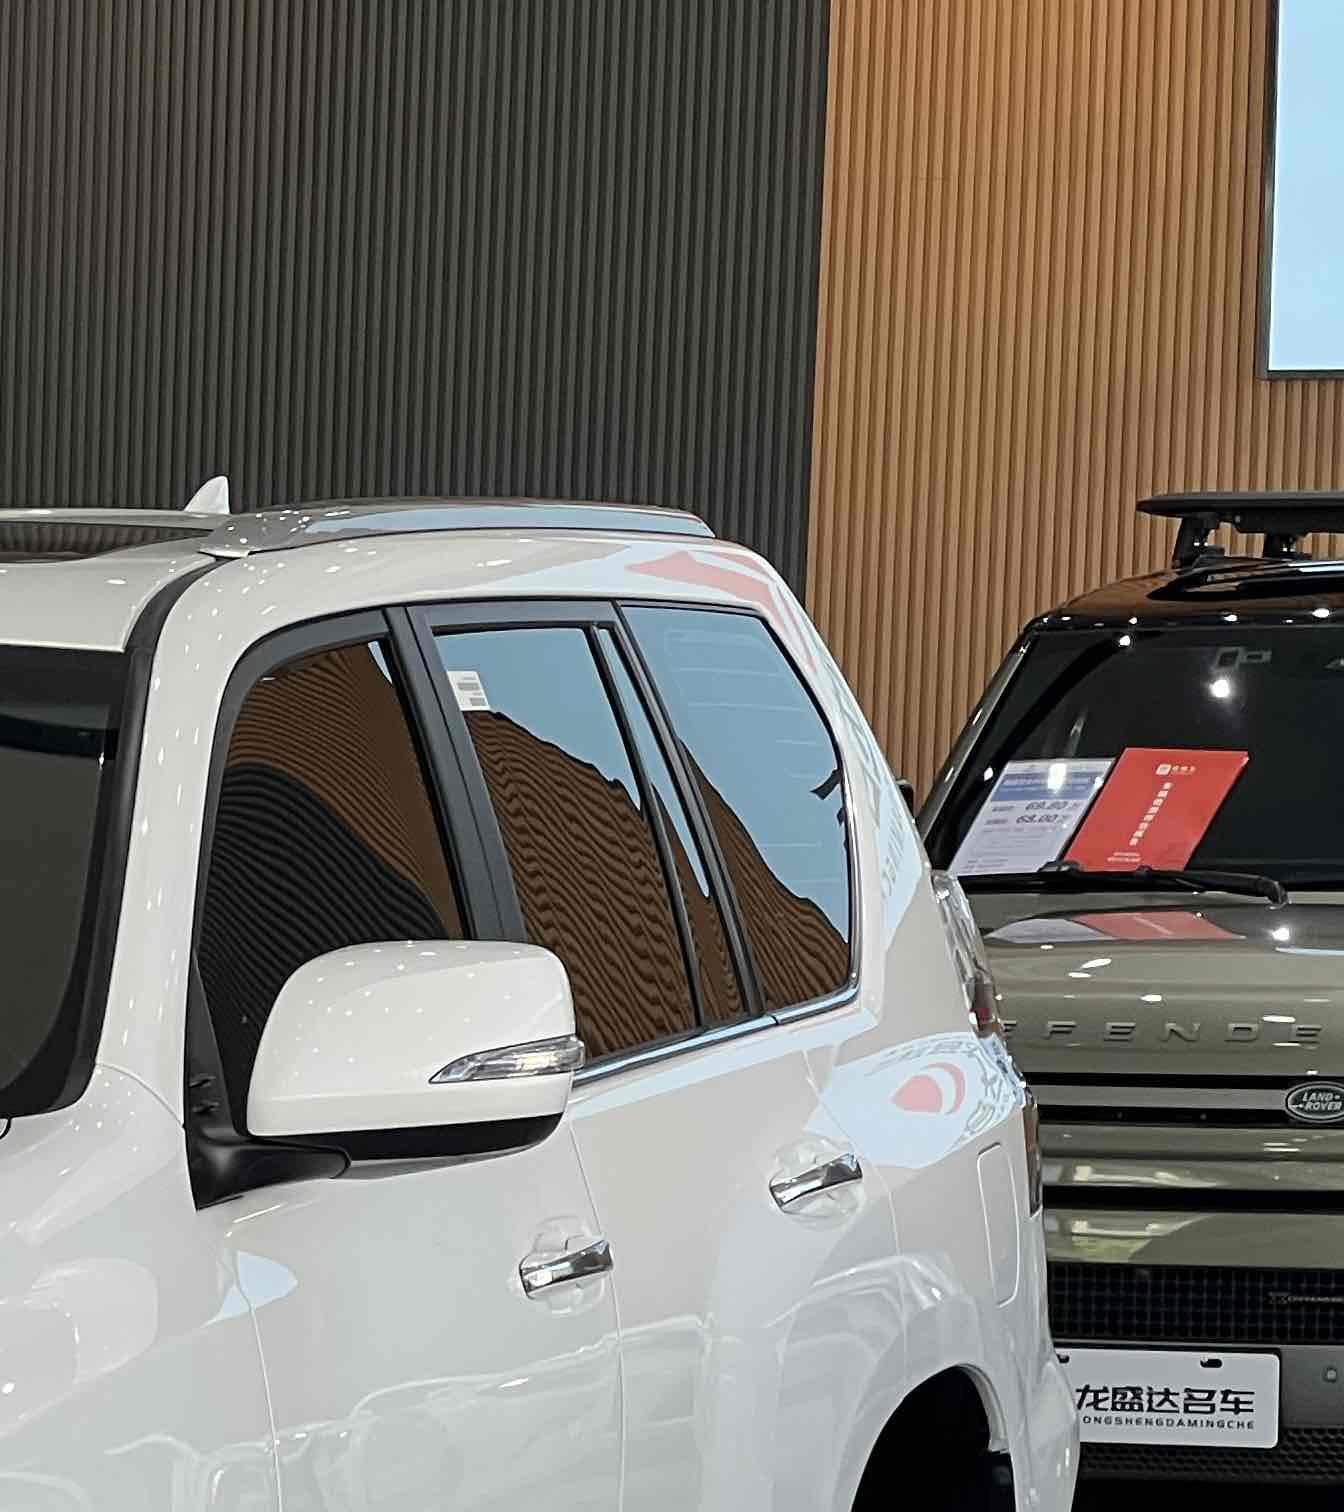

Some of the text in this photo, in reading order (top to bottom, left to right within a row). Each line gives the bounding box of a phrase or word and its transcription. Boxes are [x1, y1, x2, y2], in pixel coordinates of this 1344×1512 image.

[1305, 1101, 1342, 1111] ROVER
[1075, 1383, 1256, 1416] 龙盛达名车
[1082, 1415, 1255, 1430] ONGSHENGDAMINGCHE
